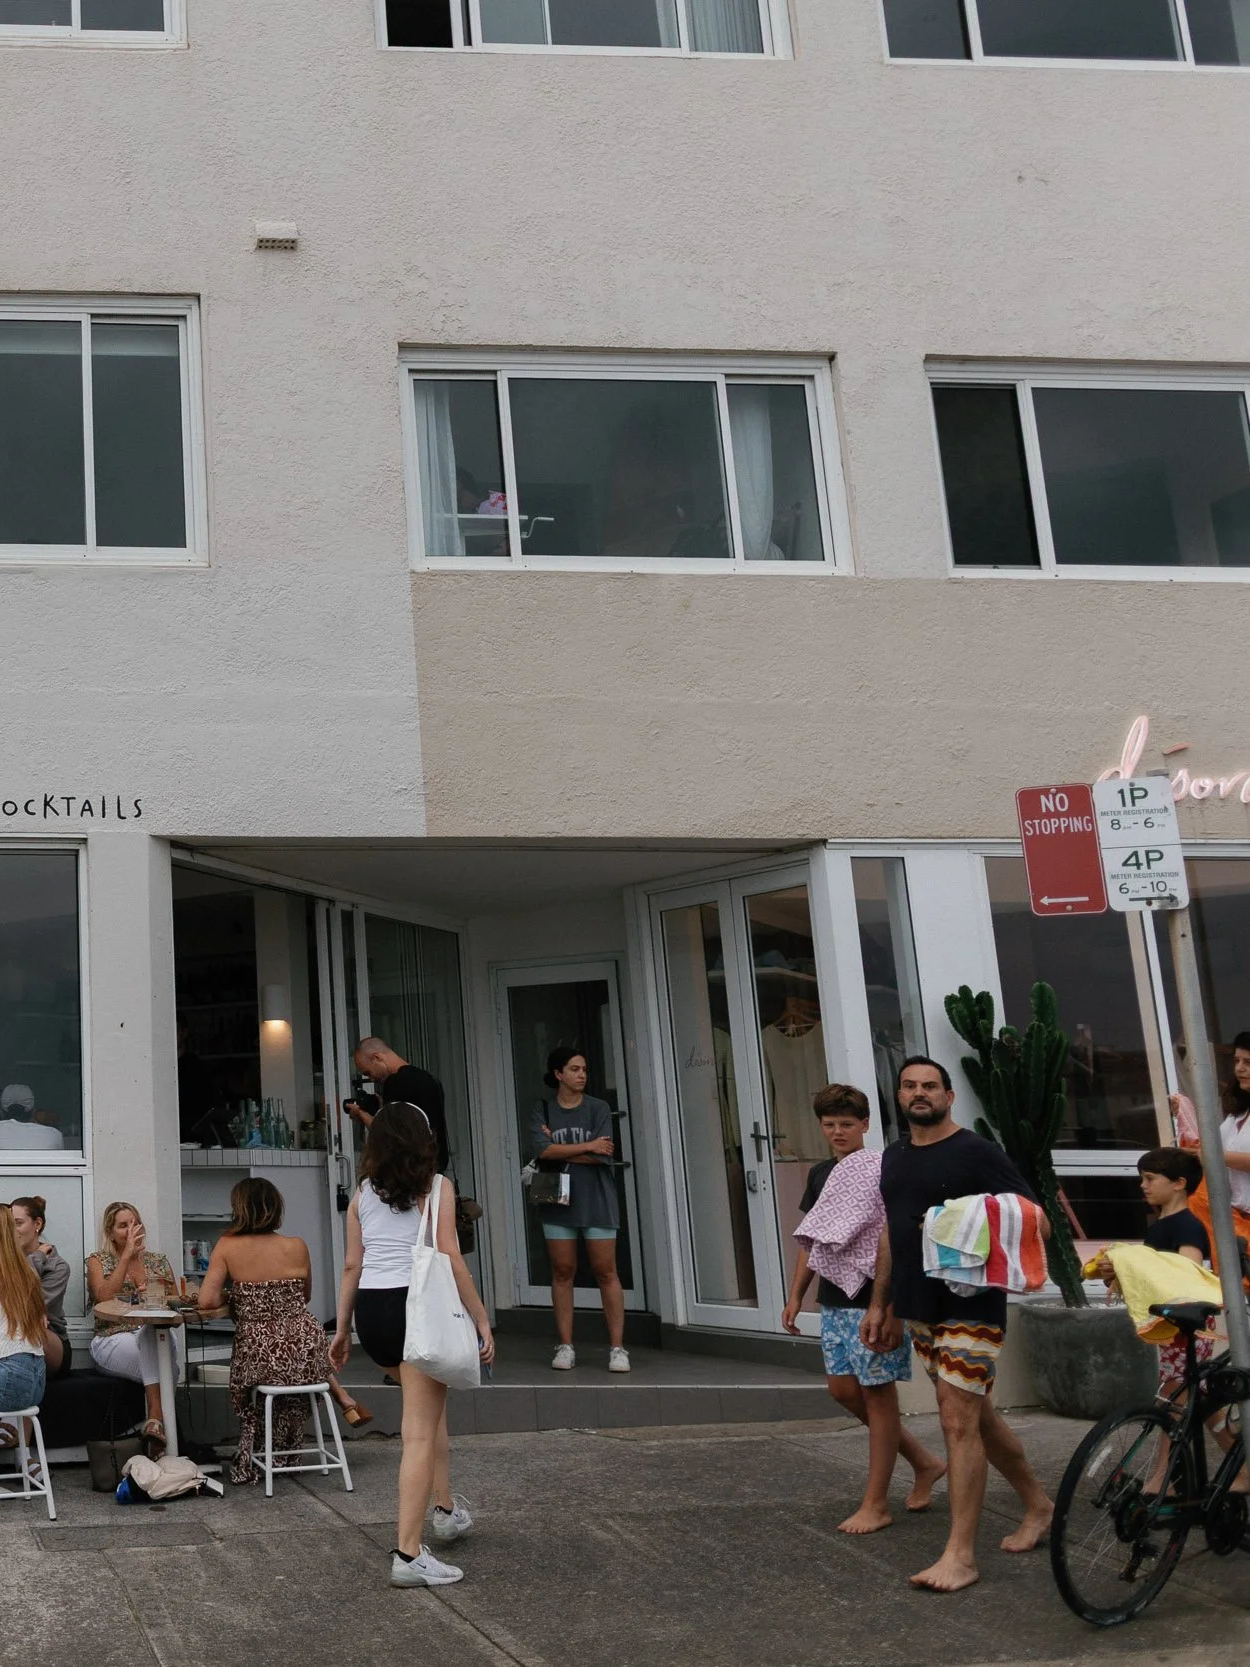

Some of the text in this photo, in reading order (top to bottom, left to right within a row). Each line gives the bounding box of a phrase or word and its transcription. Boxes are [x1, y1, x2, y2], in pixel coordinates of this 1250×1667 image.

[1039, 793, 1069, 813] NO
[1117, 786, 1149, 808] 1P
[1123, 807, 1169, 816] REGISTRATION
[1024, 815, 1093, 836] STOPPING
[1121, 849, 1165, 871] 4P
[1133, 871, 1180, 879] REGISTRATION
